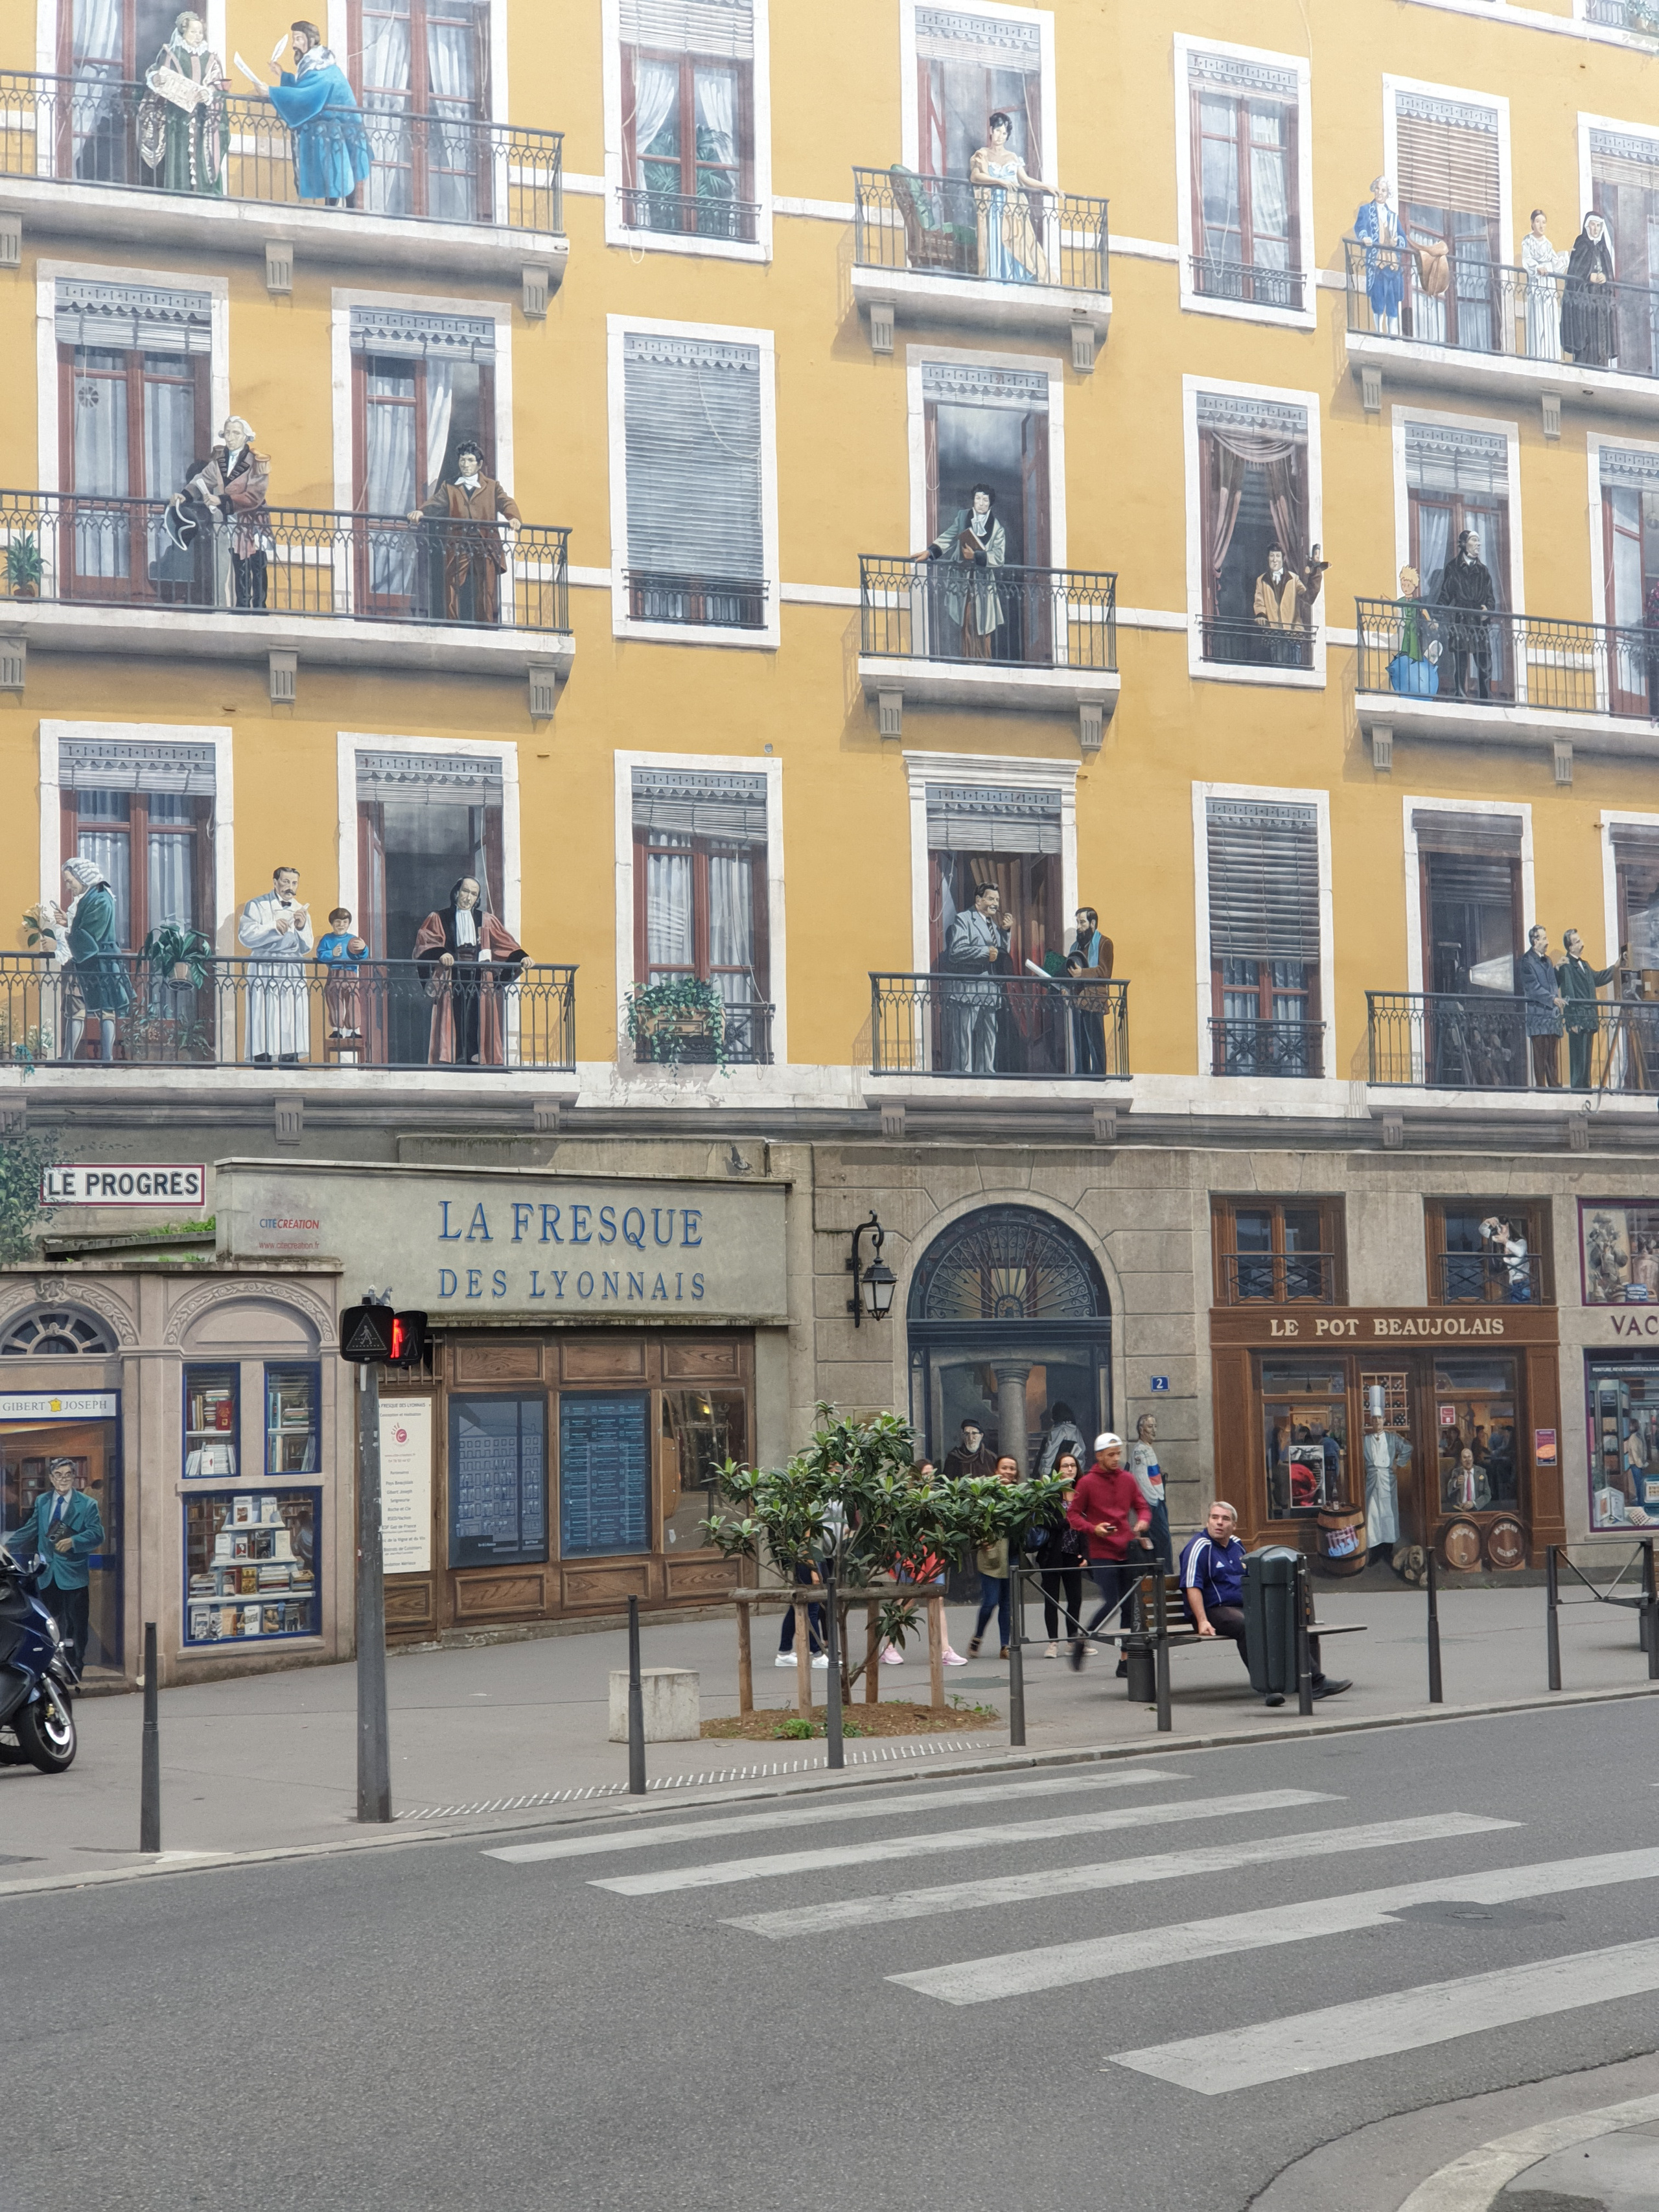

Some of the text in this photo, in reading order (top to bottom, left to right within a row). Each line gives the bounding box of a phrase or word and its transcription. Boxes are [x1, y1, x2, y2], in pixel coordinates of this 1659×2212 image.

[47, 1170, 199, 1196] LE PROGRÈS
[439, 1200, 703, 1250] LA FRESQUE
[438, 1268, 706, 1299] DES LYONNAIS
[1270, 1318, 1505, 1336] LE POT BEAUJOLAIS
[1610, 1315, 1659, 1336] VAC
[1156, 1378, 1163, 1389] 2
[2, 1400, 107, 1412] GIBERT JOSEPH
